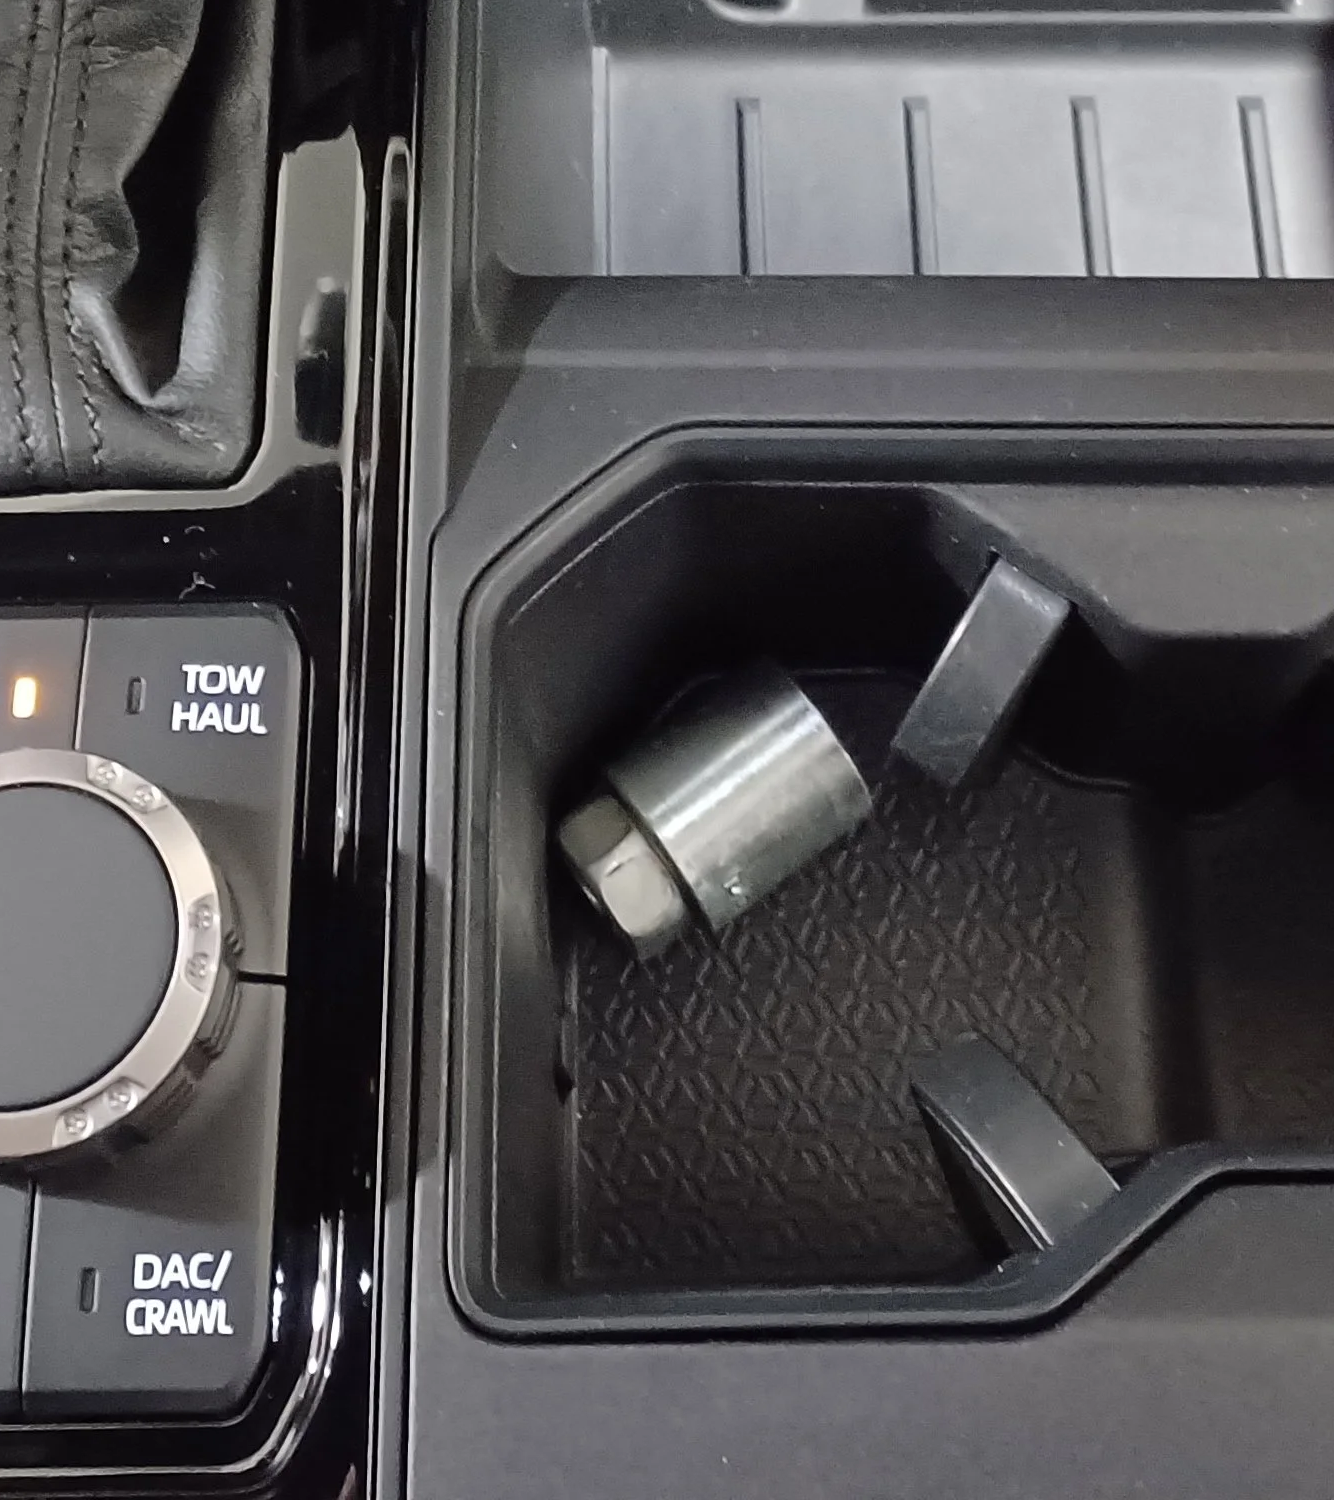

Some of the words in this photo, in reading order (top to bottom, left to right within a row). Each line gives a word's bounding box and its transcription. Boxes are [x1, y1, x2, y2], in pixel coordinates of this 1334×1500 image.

[181, 663, 267, 695] TOW
[171, 701, 268, 736] HAUL
[132, 1249, 233, 1292] DAC/
[125, 1300, 234, 1336] CRAWL
